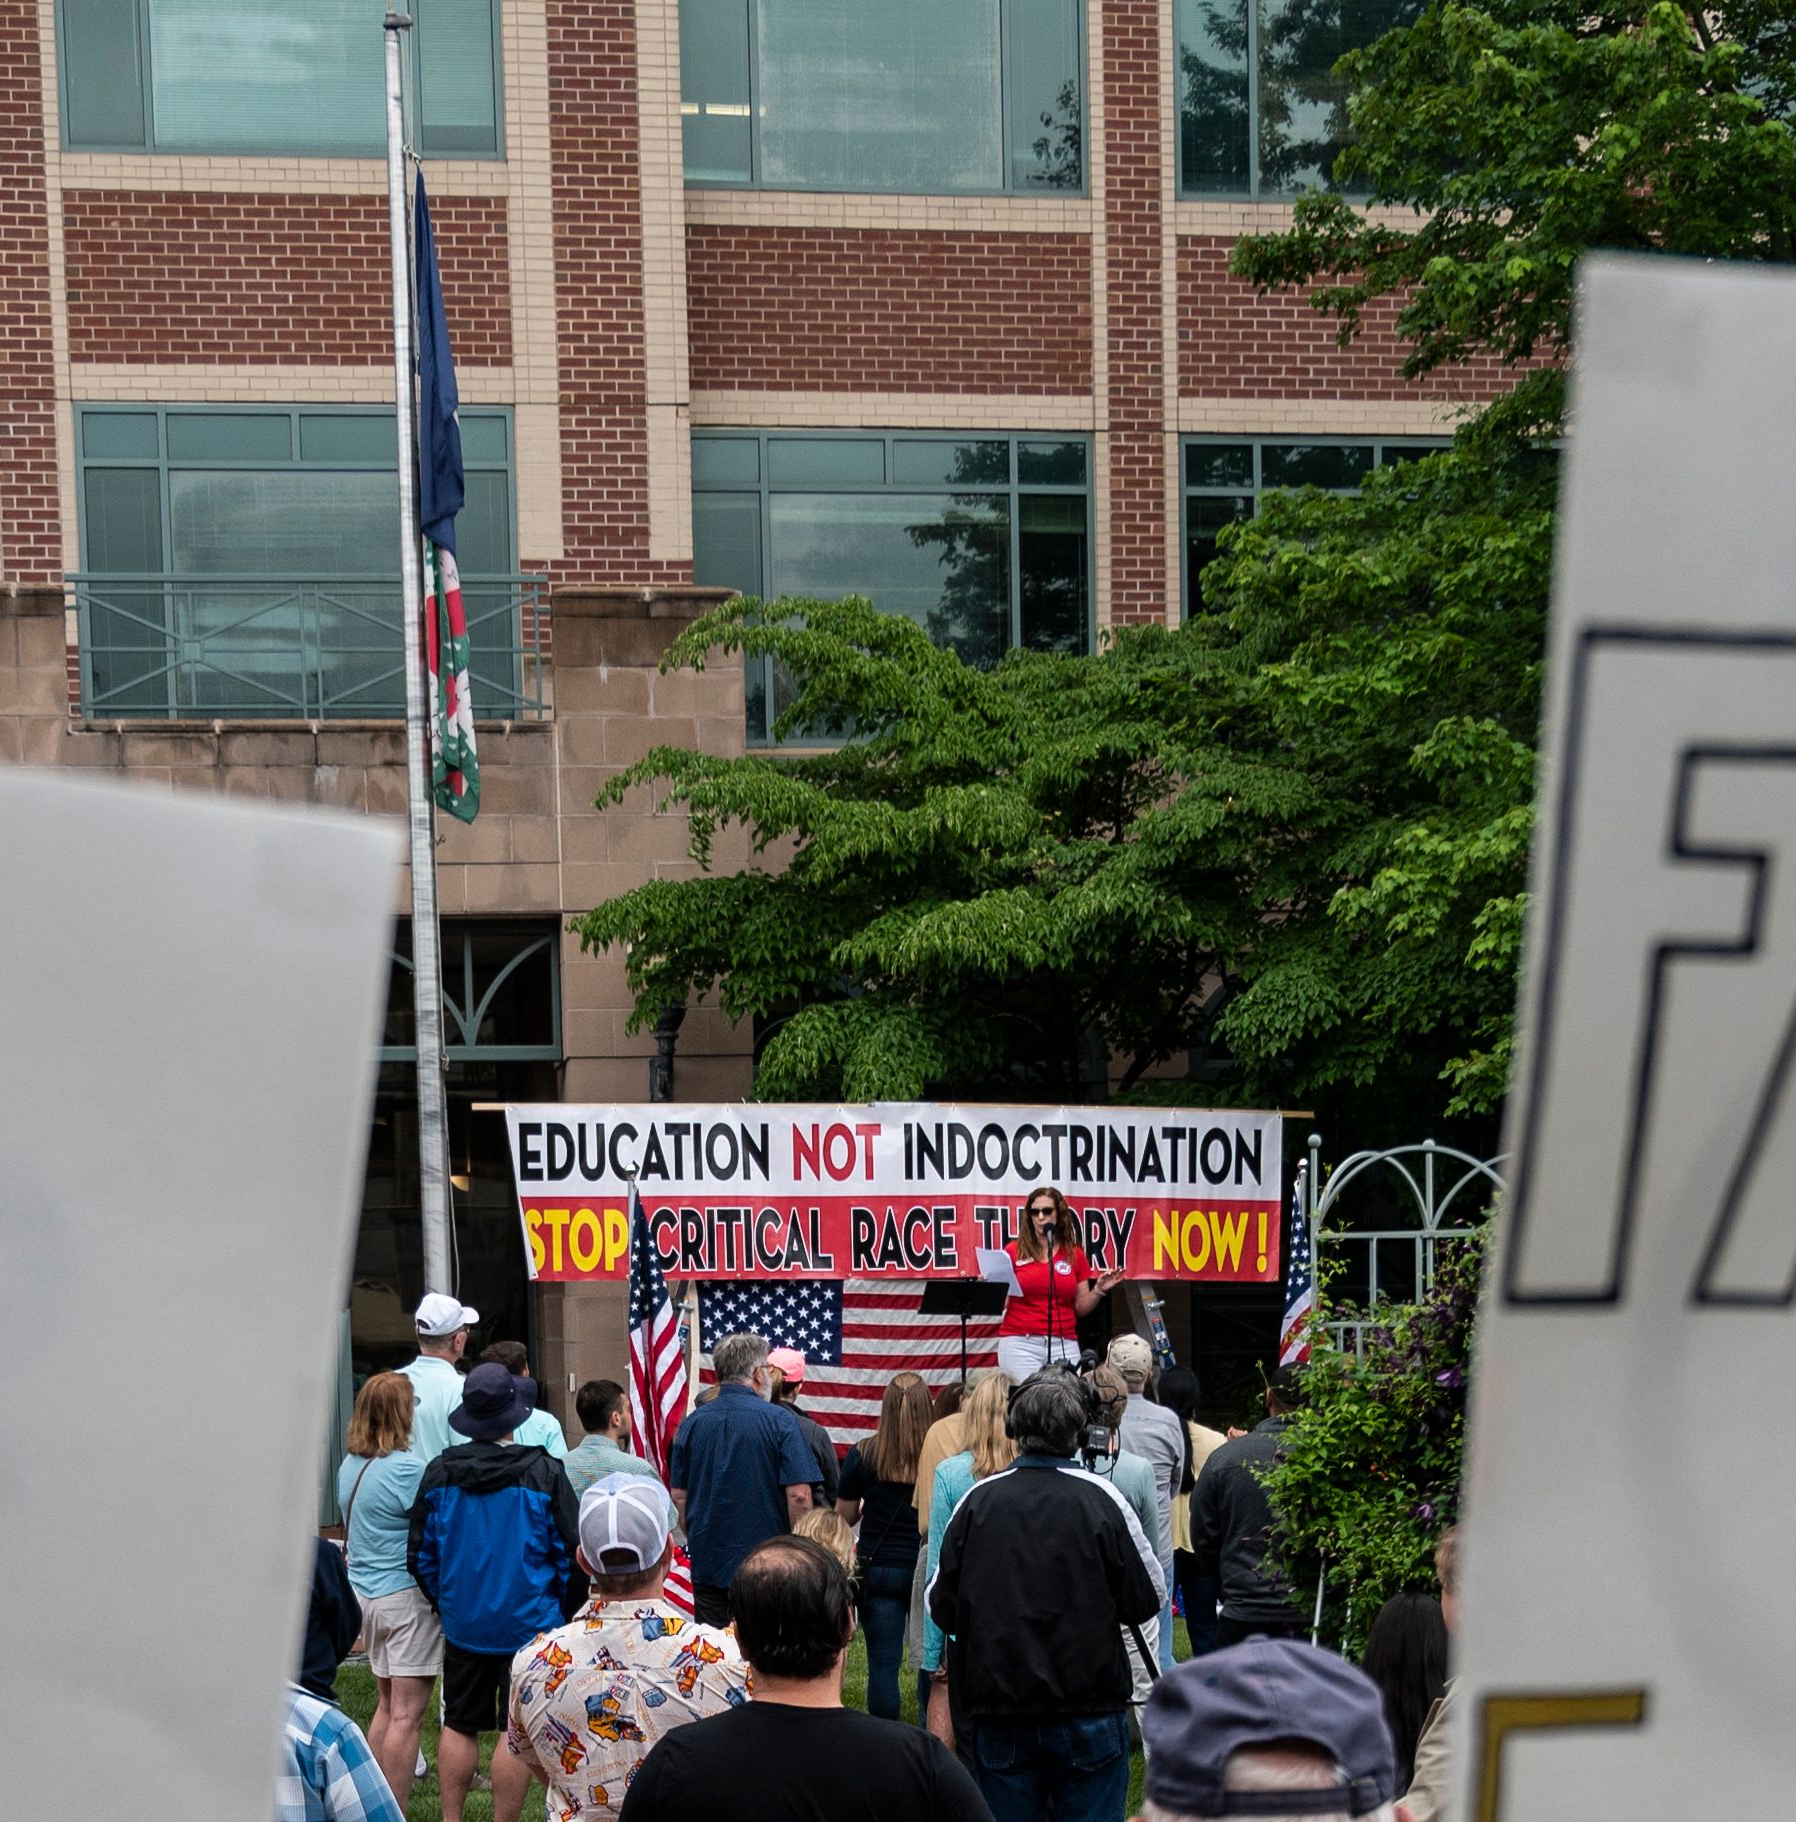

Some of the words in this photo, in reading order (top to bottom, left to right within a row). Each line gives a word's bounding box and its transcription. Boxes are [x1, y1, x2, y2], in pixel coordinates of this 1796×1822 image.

[518, 1122, 770, 1182] EDUCATION
[792, 1122, 882, 1182] NOT
[903, 1122, 1263, 1186] INDOCTRINATION
[525, 1208, 630, 1272] STOP
[648, 1206, 835, 1272] CRITICAL
[851, 1205, 959, 1271] RACE
[973, 1205, 1137, 1272] THRY
[1153, 1210, 1268, 1273] NOW!
